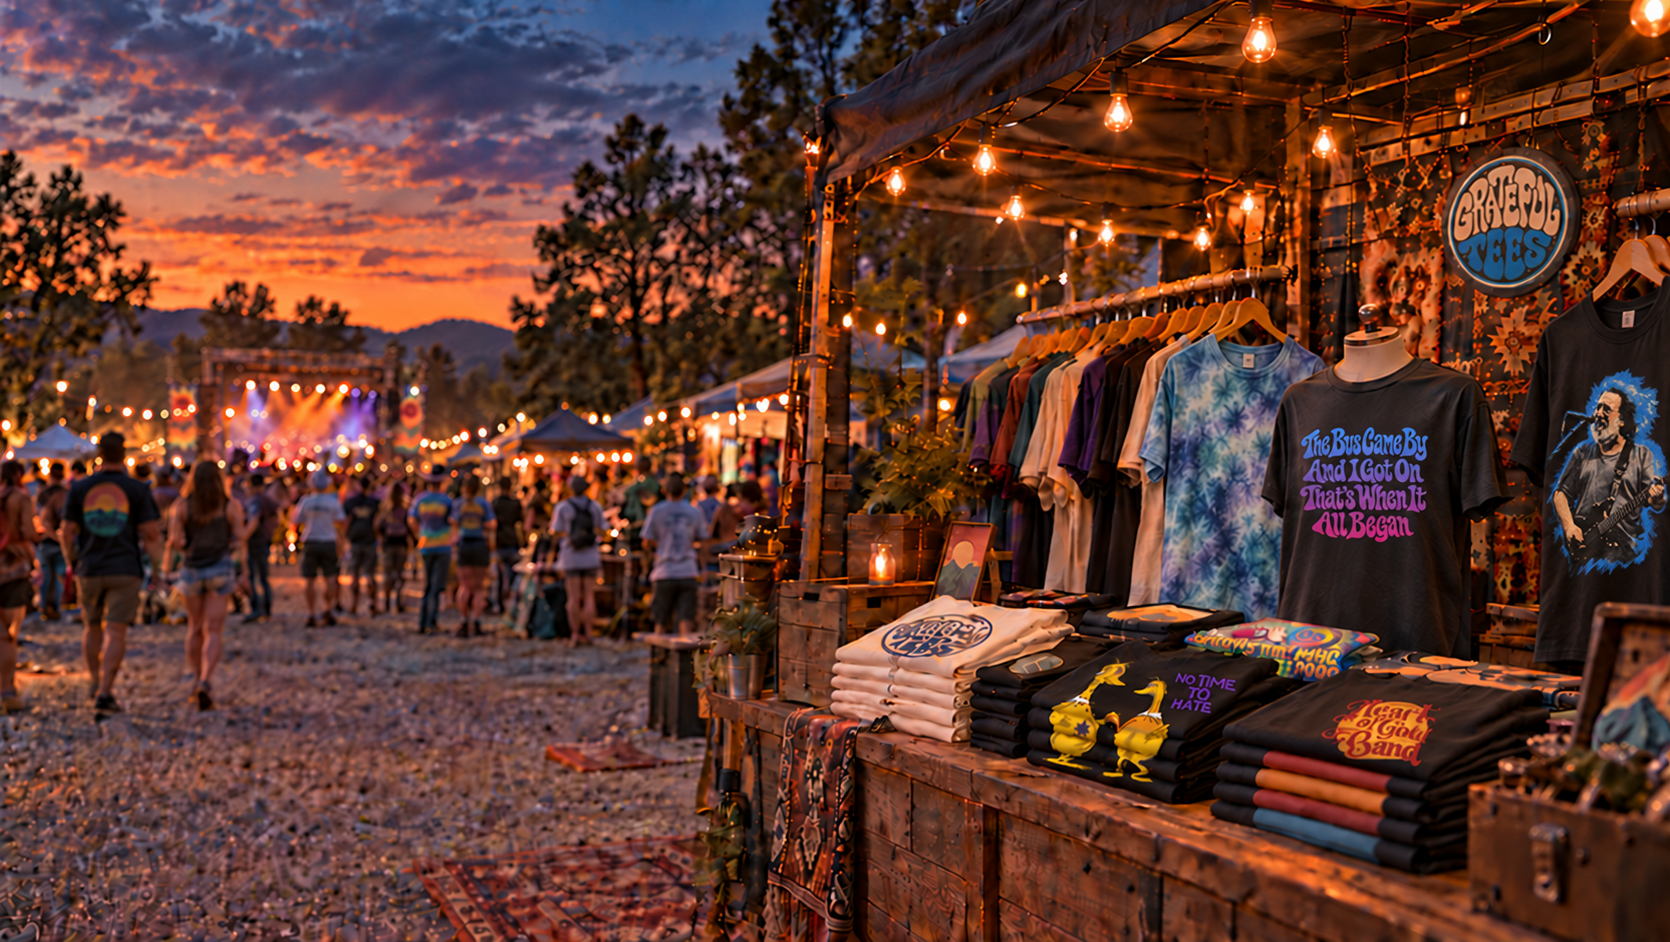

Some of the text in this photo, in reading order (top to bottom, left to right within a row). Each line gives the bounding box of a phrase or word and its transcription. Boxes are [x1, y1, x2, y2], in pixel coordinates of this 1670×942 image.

[1454, 165, 1560, 241] GRATEFUL
[1458, 227, 1552, 280] TEES
[1301, 426, 1428, 461] The Bus Came By
[1303, 458, 1424, 483] And I Got On
[1300, 484, 1427, 513] That's When It
[1311, 511, 1414, 542] All Began
[1175, 673, 1236, 692] NO TIME
[1189, 686, 1211, 701] TO
[1170, 698, 1212, 714] HATE
[1333, 730, 1422, 767] Band
